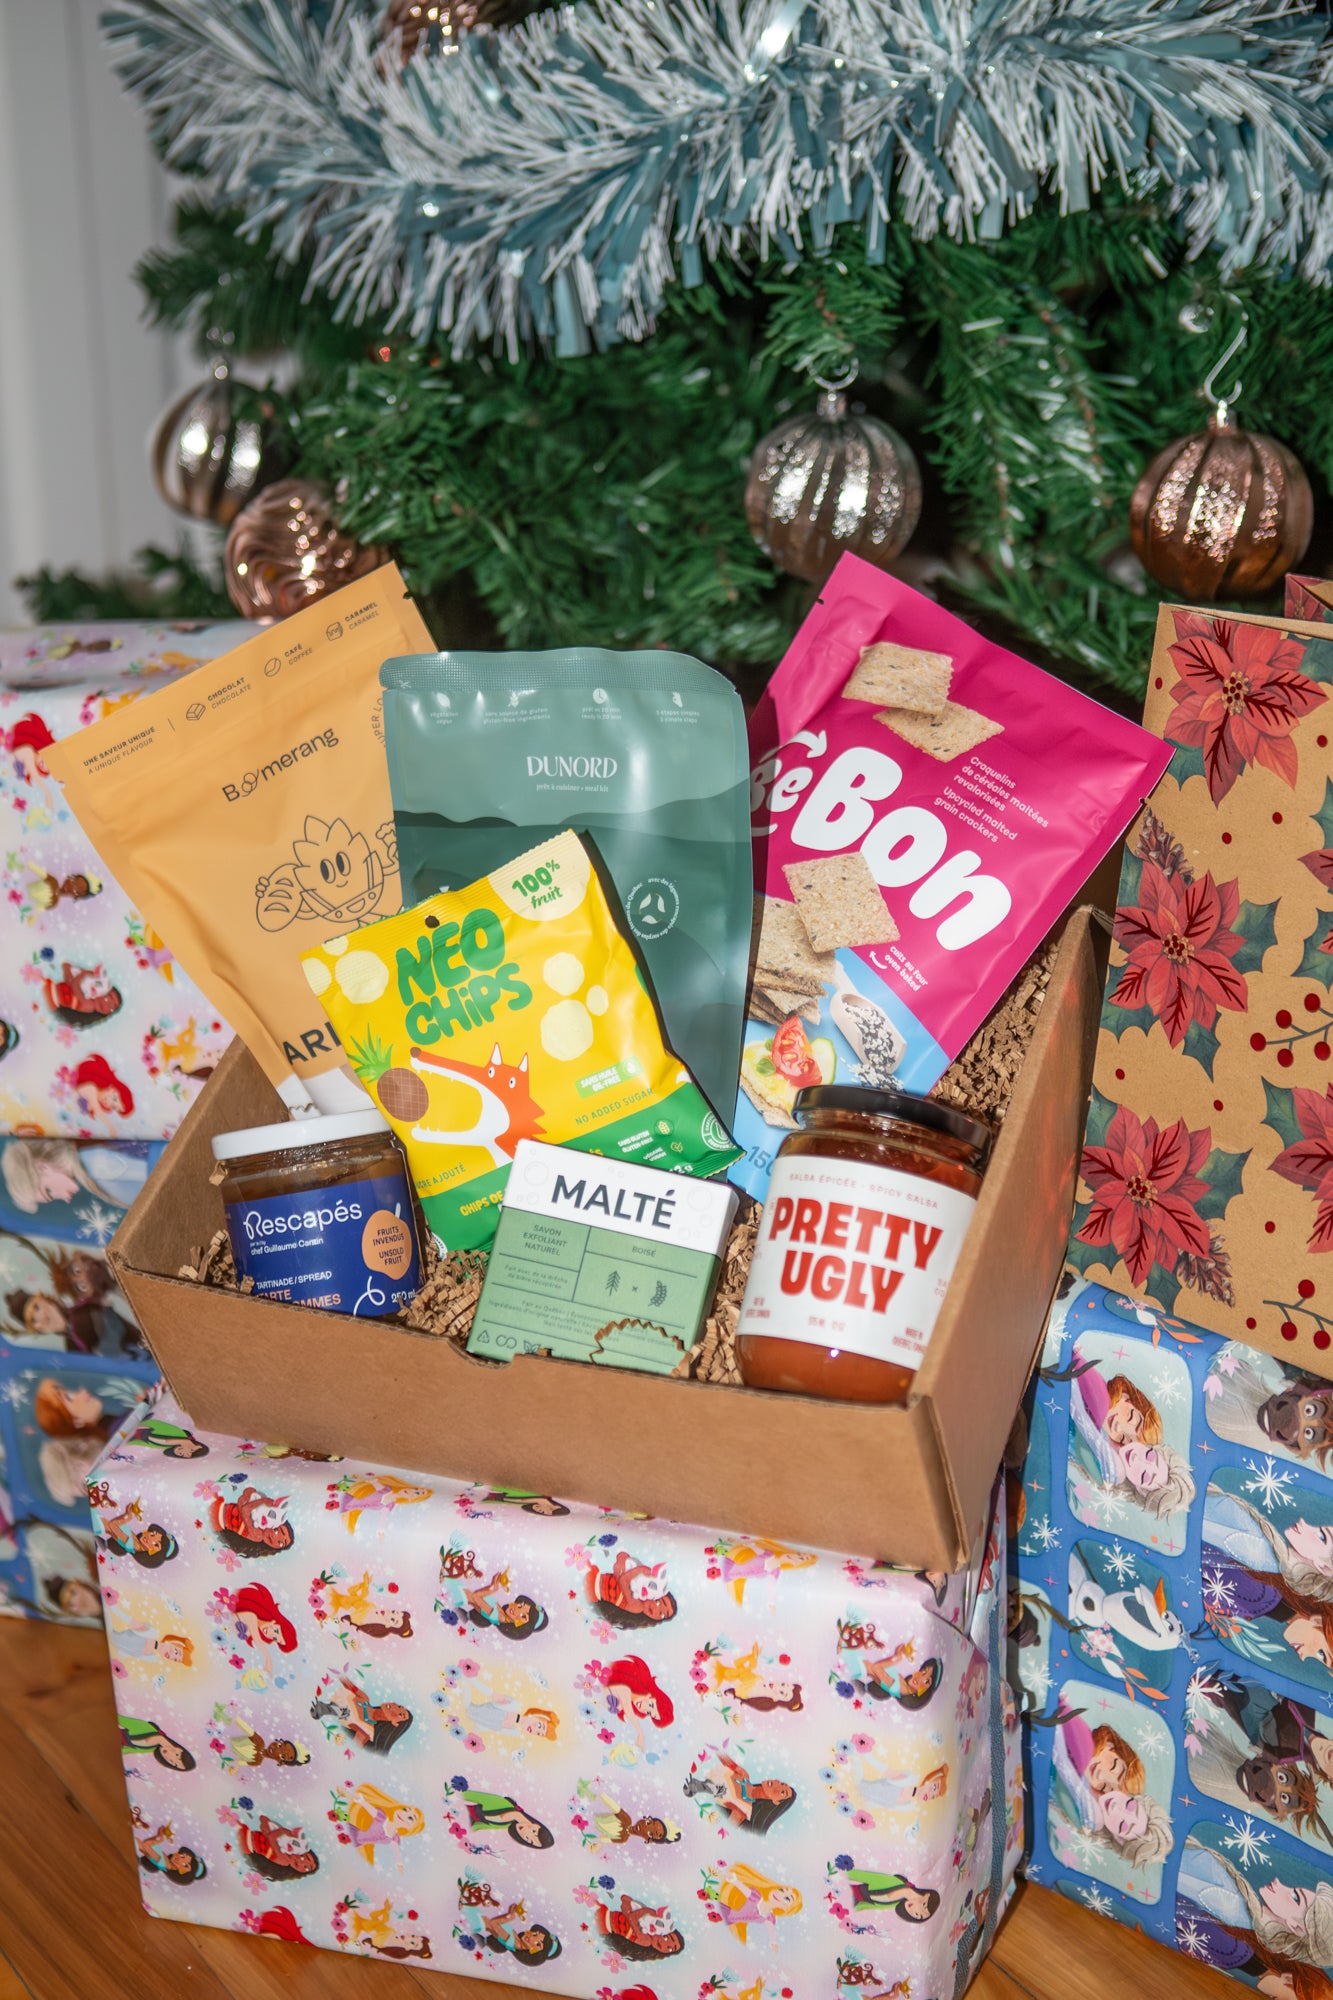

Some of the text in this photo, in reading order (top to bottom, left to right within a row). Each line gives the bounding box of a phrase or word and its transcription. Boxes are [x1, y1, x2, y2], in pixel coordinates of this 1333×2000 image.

[345, 602, 378, 622] CARAMEL
[349, 610, 379, 630] CARAMEL
[288, 647, 313, 665] COFFEE
[207, 677, 245, 702] CHOCOLAT
[211, 683, 252, 709] CHOCOLATE
[83, 726, 156, 767] UNE SAVEUR UNIQUE
[95, 754, 121, 772] UNIQUE
[122, 737, 154, 757] FLAVOUR
[222, 727, 340, 802] Boomerang
[527, 755, 618, 779] DUNORD
[970, 756, 1017, 790] Craquelins
[953, 774, 1006, 812] revalorisées
[962, 765, 1049, 829] de céréales maltées
[934, 797, 999, 843] grain crackers
[943, 786, 1018, 841] Upcycled malted
[512, 859, 561, 897] 100%
[531, 886, 563, 910] fruit
[395, 908, 506, 1002] NEO
[890, 945, 929, 986] cuits au four
[884, 954, 922, 992] oven baked
[575, 1087, 654, 1125] NO ADDED SUGAR
[432, 1162, 467, 1184] AJOUTÉ
[460, 1190, 504, 1217] CHIPS DE
[551, 1174, 676, 1230] MALTÉ
[789, 1173, 939, 1209] SALSA ÉPICÉE SPICY SALSA
[243, 1199, 362, 1240] Rescapés
[377, 1226, 399, 1236] FRUITS
[533, 1224, 562, 1236] SAVON
[768, 1196, 945, 1272] PRETTY
[250, 1247, 263, 1256] chef
[263, 1241, 298, 1254] Guillaume
[372, 1233, 405, 1247] INVENDUS
[378, 1247, 404, 1259] UNSOLD
[523, 1231, 568, 1248] EXFOLIANT
[524, 1242, 561, 1256] NATUREL
[384, 1255, 402, 1266] FRUIT
[779, 1248, 906, 1316] UGLY
